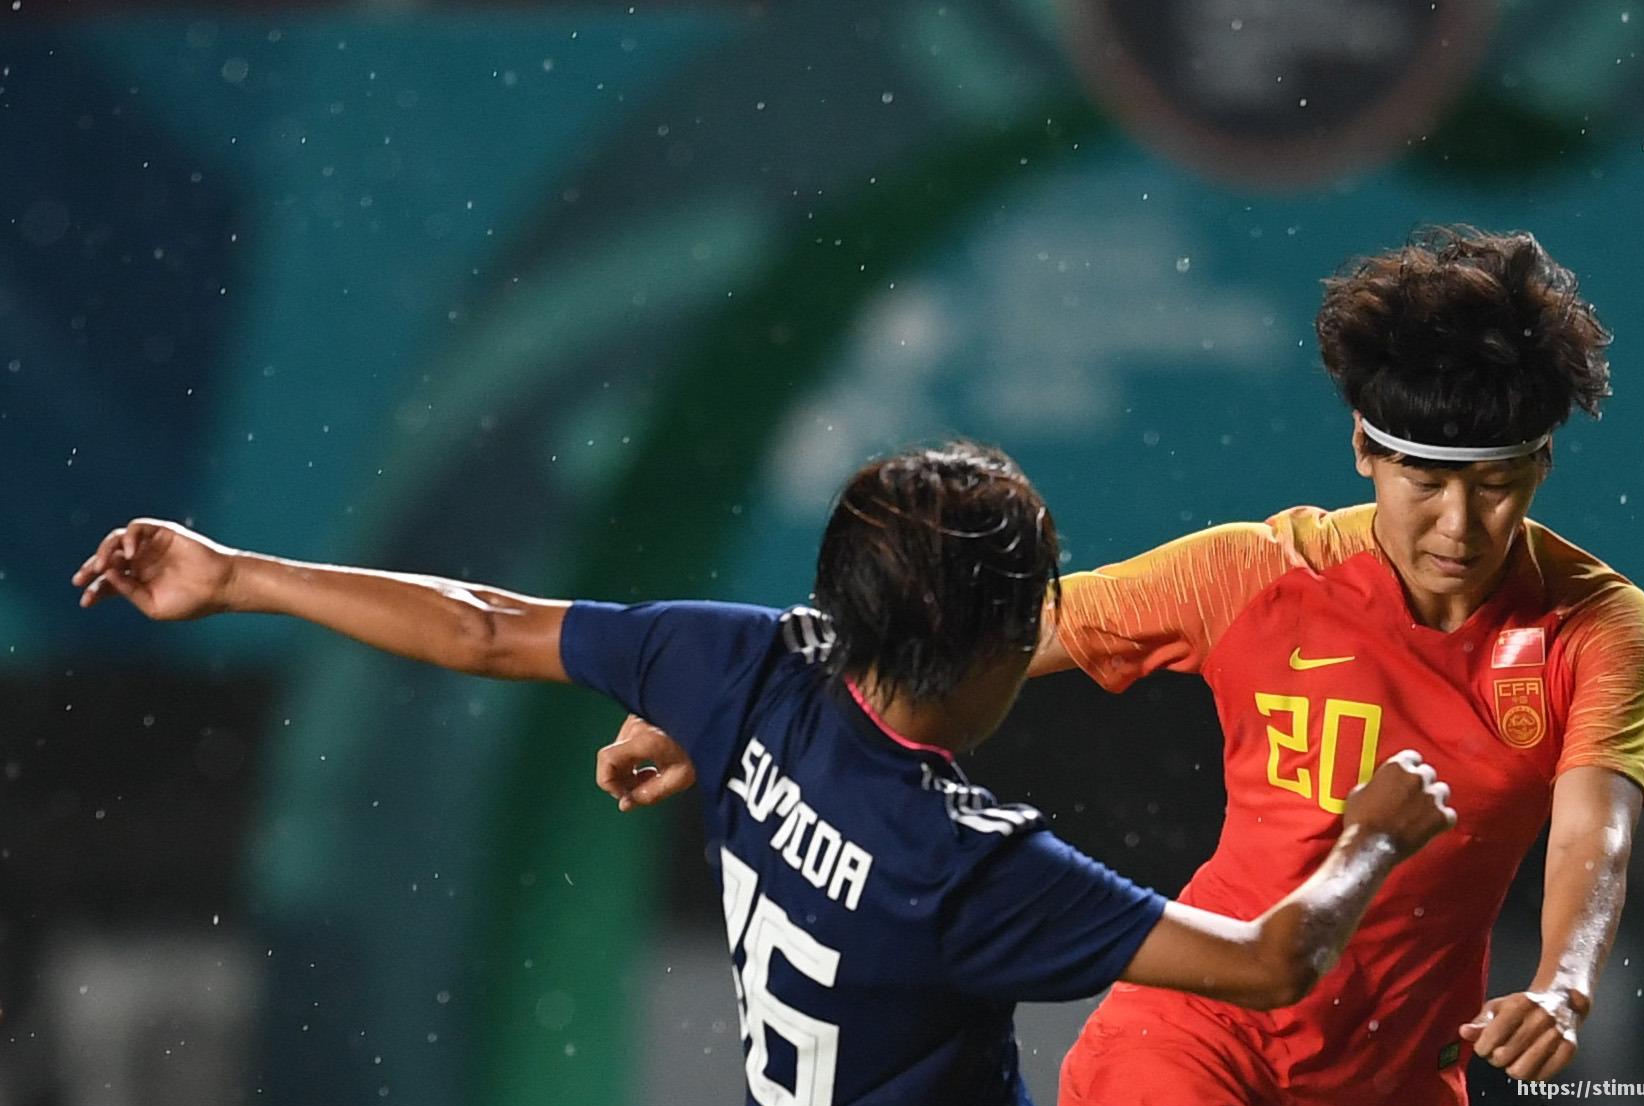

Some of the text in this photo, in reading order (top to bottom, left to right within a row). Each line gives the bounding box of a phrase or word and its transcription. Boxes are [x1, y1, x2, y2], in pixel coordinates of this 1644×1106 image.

[1498, 682, 1540, 697] CFA
[1254, 692, 1382, 814] 20
[727, 736, 873, 911] SUMIDA
